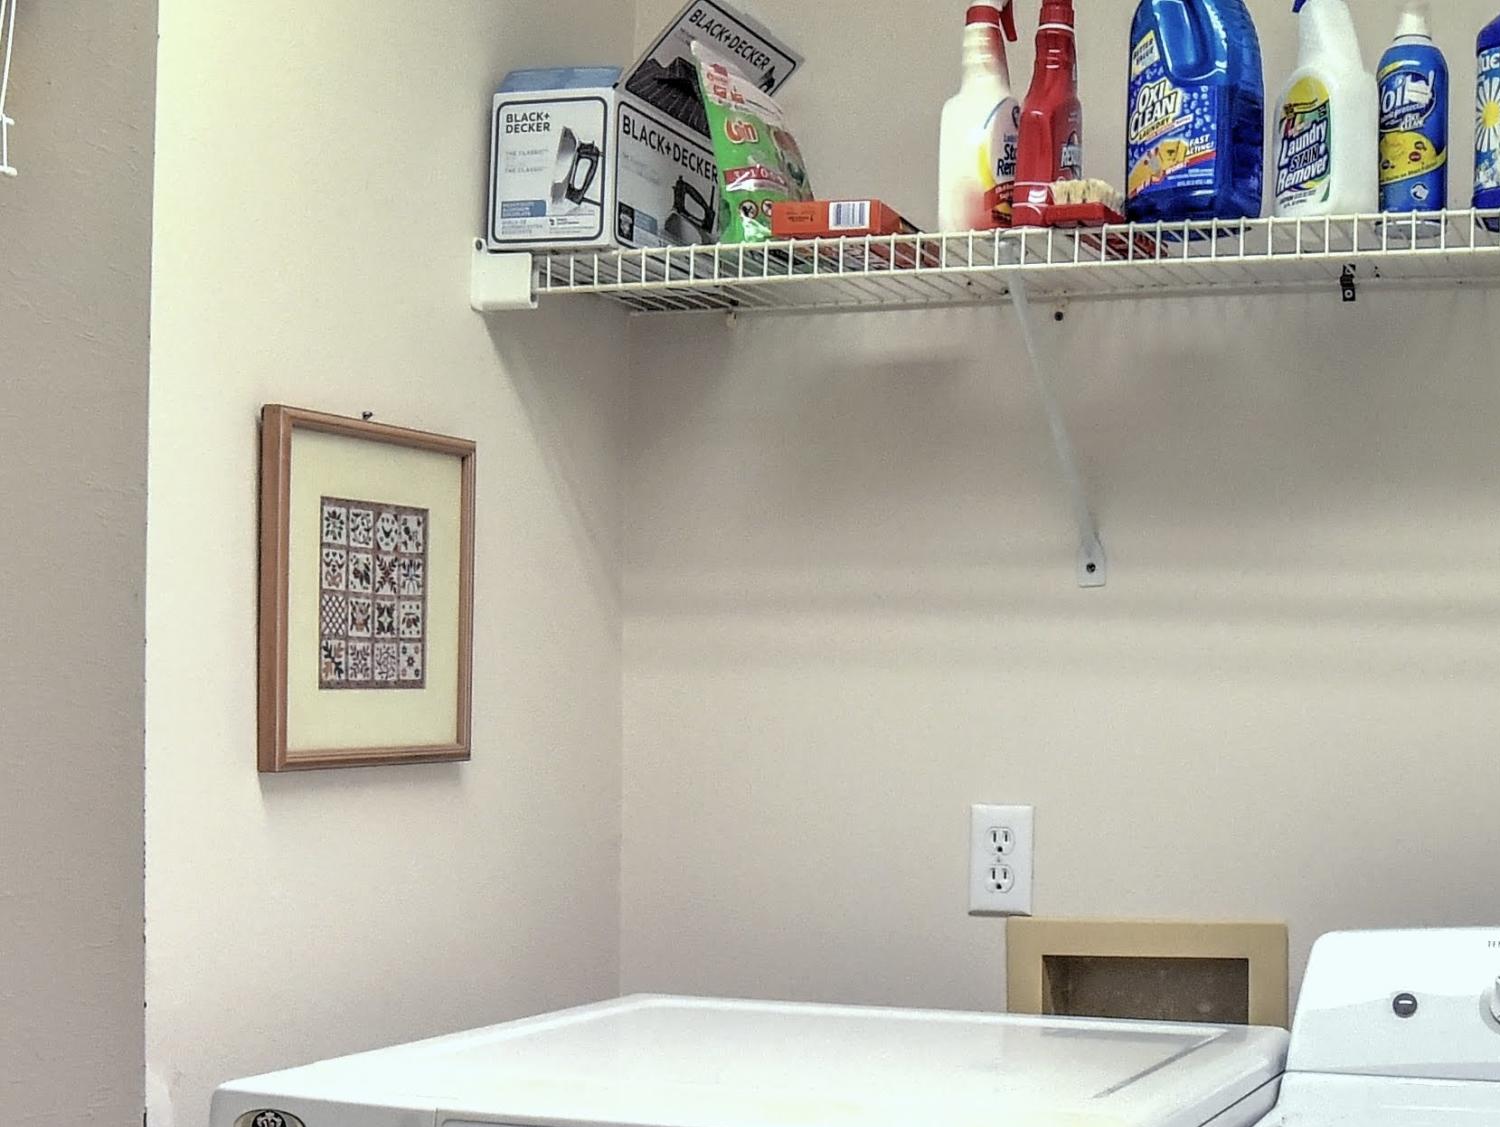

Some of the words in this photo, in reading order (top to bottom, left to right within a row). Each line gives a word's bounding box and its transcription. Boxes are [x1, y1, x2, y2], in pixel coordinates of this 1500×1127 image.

[688, 9, 771, 71] BLACK+DECKER
[1138, 79, 1167, 113] OXI
[506, 112, 550, 123] BLACK+
[506, 122, 551, 134] DECKER
[1130, 91, 1178, 140] CLEAN
[622, 114, 718, 184] BLACK+DECKER
[1190, 134, 1211, 147] FAST
[1280, 120, 1327, 167] Laundry
[1290, 146, 1318, 172] STAIN
[1277, 153, 1328, 195] Remover
